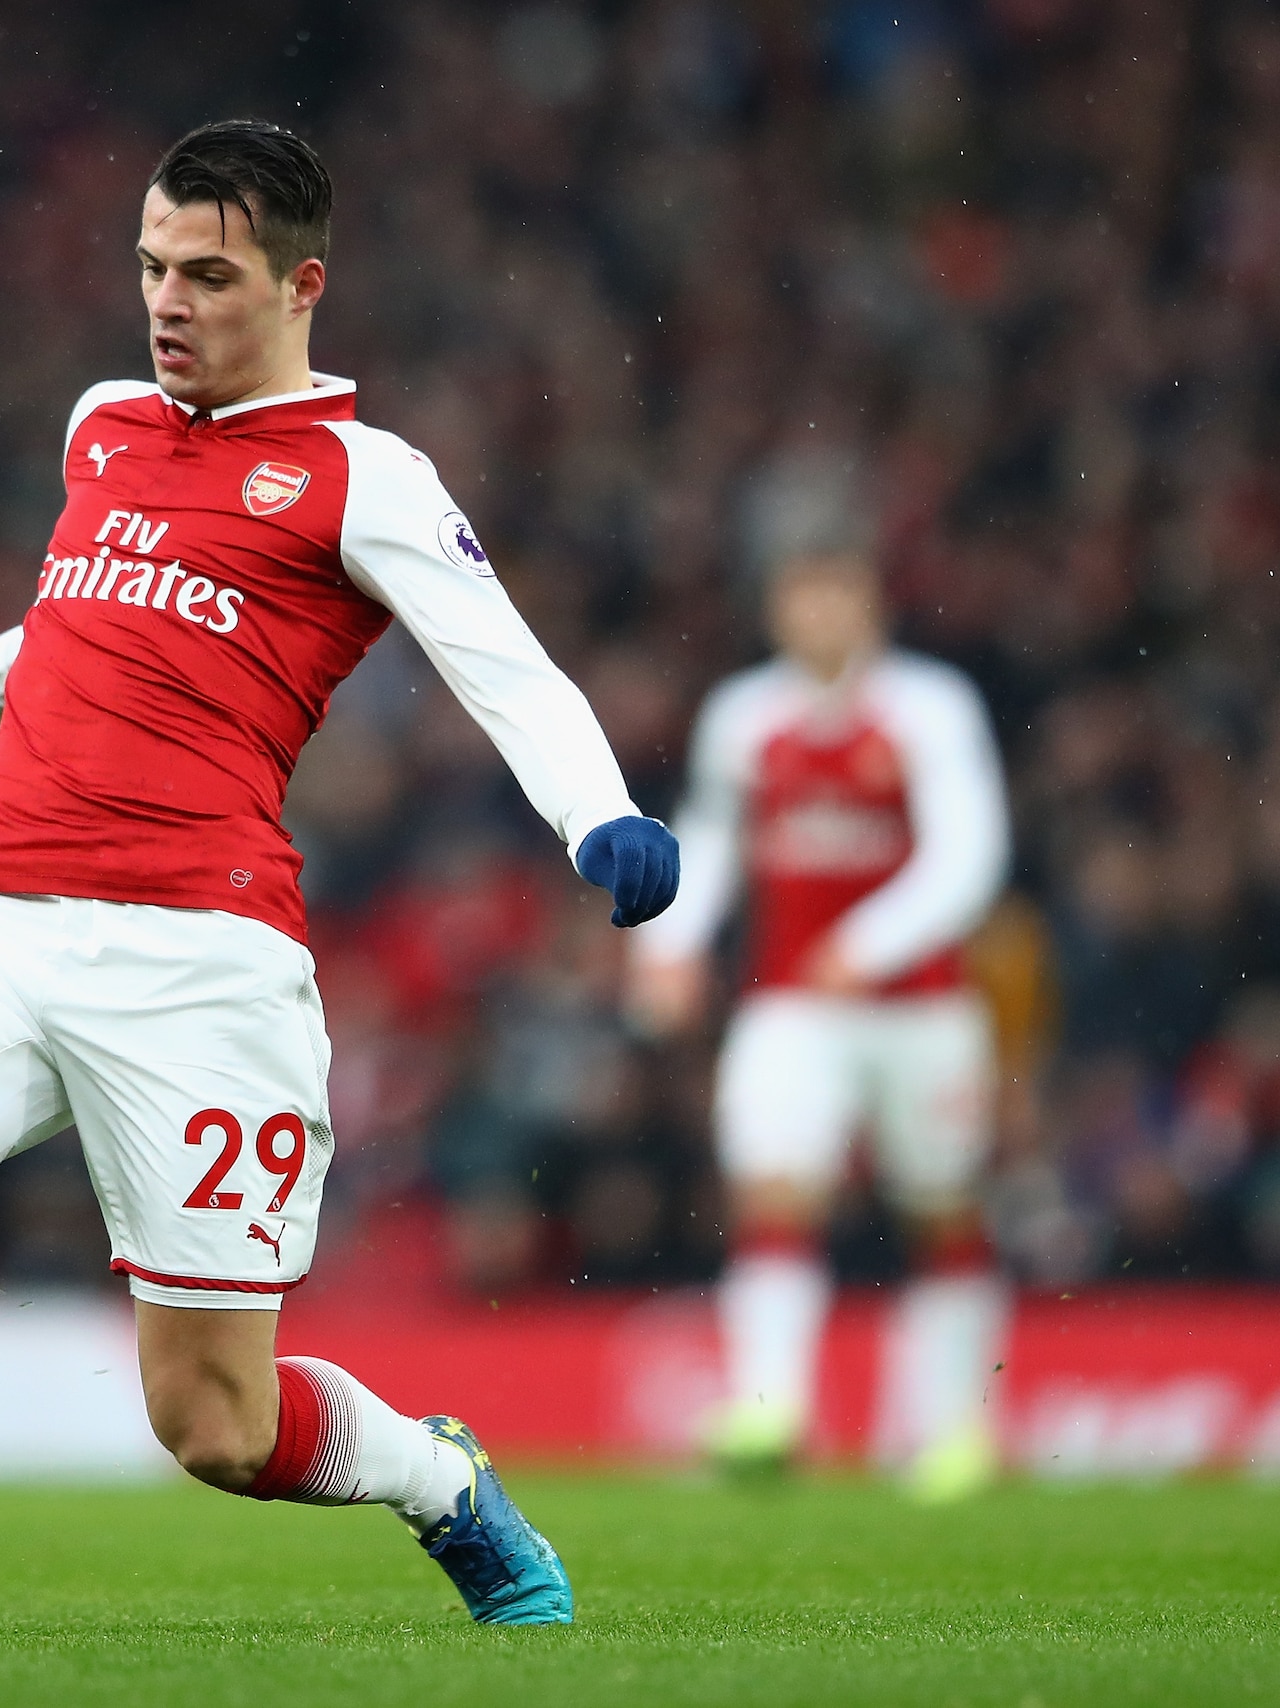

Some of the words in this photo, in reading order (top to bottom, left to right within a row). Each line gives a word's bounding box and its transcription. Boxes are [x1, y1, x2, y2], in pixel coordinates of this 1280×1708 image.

[258, 467, 303, 487] Arsenal
[94, 510, 170, 554] Fly
[182, 1108, 306, 1213] 29
